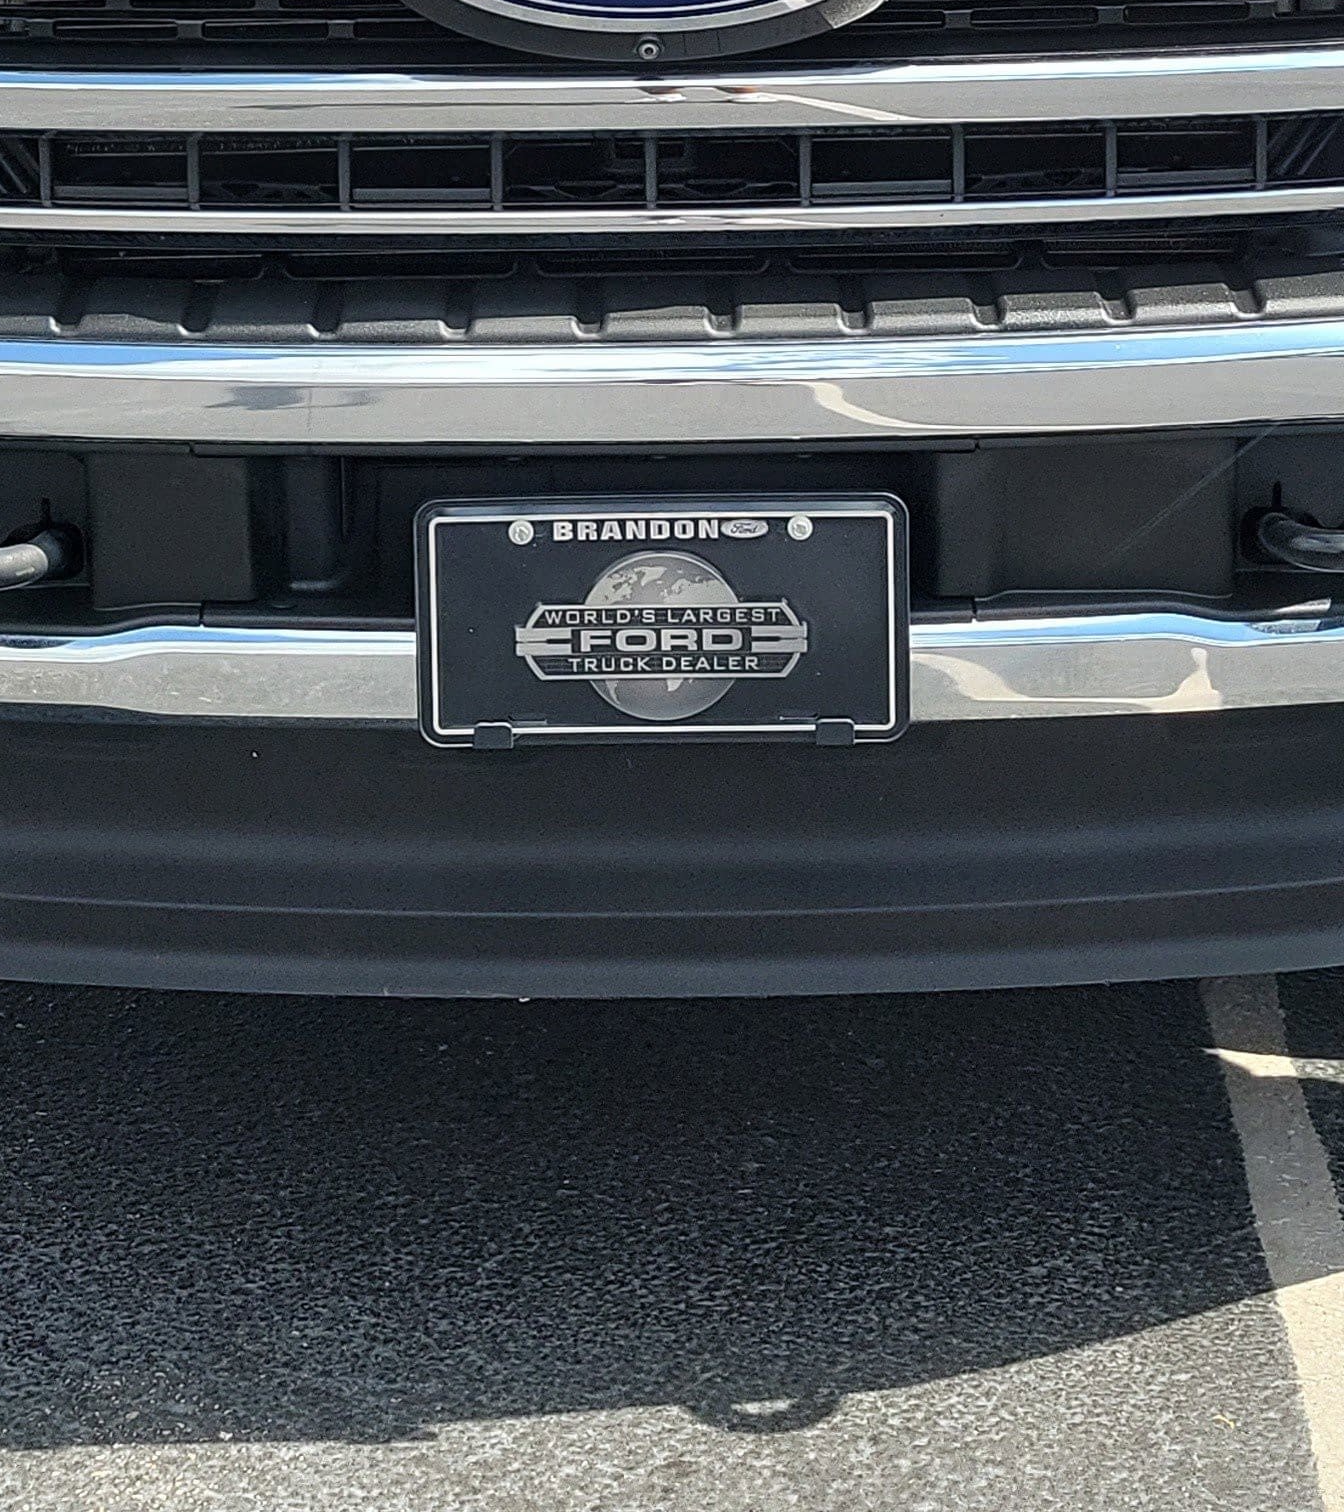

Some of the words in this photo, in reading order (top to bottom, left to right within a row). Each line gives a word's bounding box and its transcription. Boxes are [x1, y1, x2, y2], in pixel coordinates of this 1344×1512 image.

[552, 519, 719, 542] BRANDON
[545, 609, 657, 626] WORLD'S
[667, 608, 781, 625] LARGEST
[580, 628, 744, 652] FORD
[569, 657, 651, 673] TRUCK
[662, 656, 760, 672] DEALER
